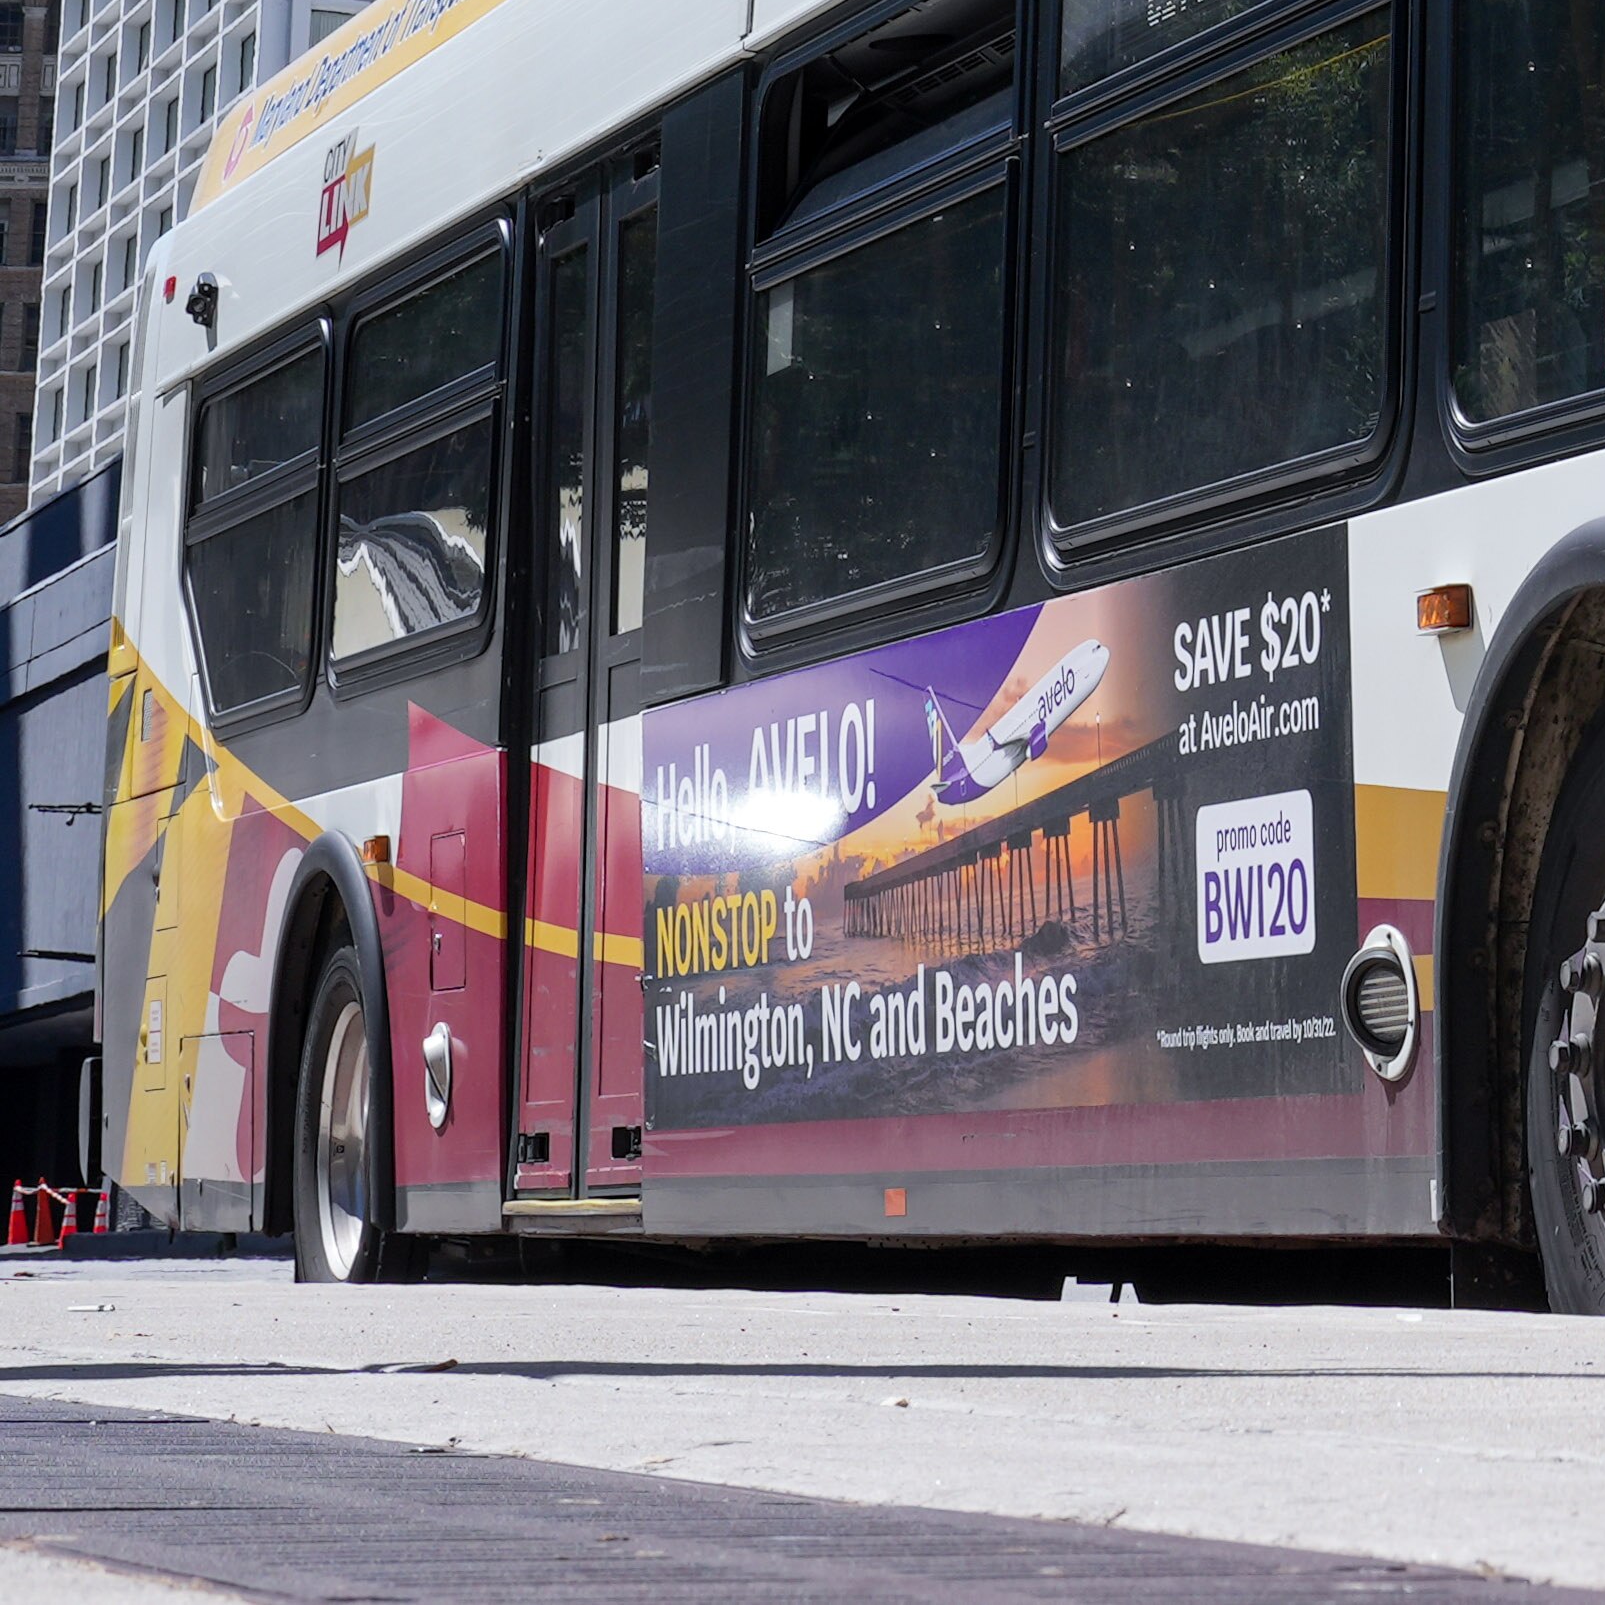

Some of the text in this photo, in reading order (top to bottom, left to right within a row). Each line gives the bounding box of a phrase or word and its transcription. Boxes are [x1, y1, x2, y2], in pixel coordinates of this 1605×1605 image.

[324, 135, 352, 184] CITY
[319, 162, 372, 244] LINK
[1173, 615, 1251, 693] SAVE
[1038, 664, 1075, 722] avelo
[1178, 694, 1319, 756] at AveloAir.com
[1216, 810, 1291, 863] promo code
[656, 885, 813, 980] NONSTOP to
[1204, 858, 1308, 944] BWI20
[656, 951, 1079, 1091] Wilmington, NC and Beaches
[1183, 1025, 1195, 1051] trip
[1236, 1020, 1254, 1043] Book
[1255, 1019, 1269, 1042] and
[1270, 1018, 1291, 1040] travel
[1292, 1018, 1302, 1044] by
[1303, 1015, 1337, 1040] 10/31/22.
